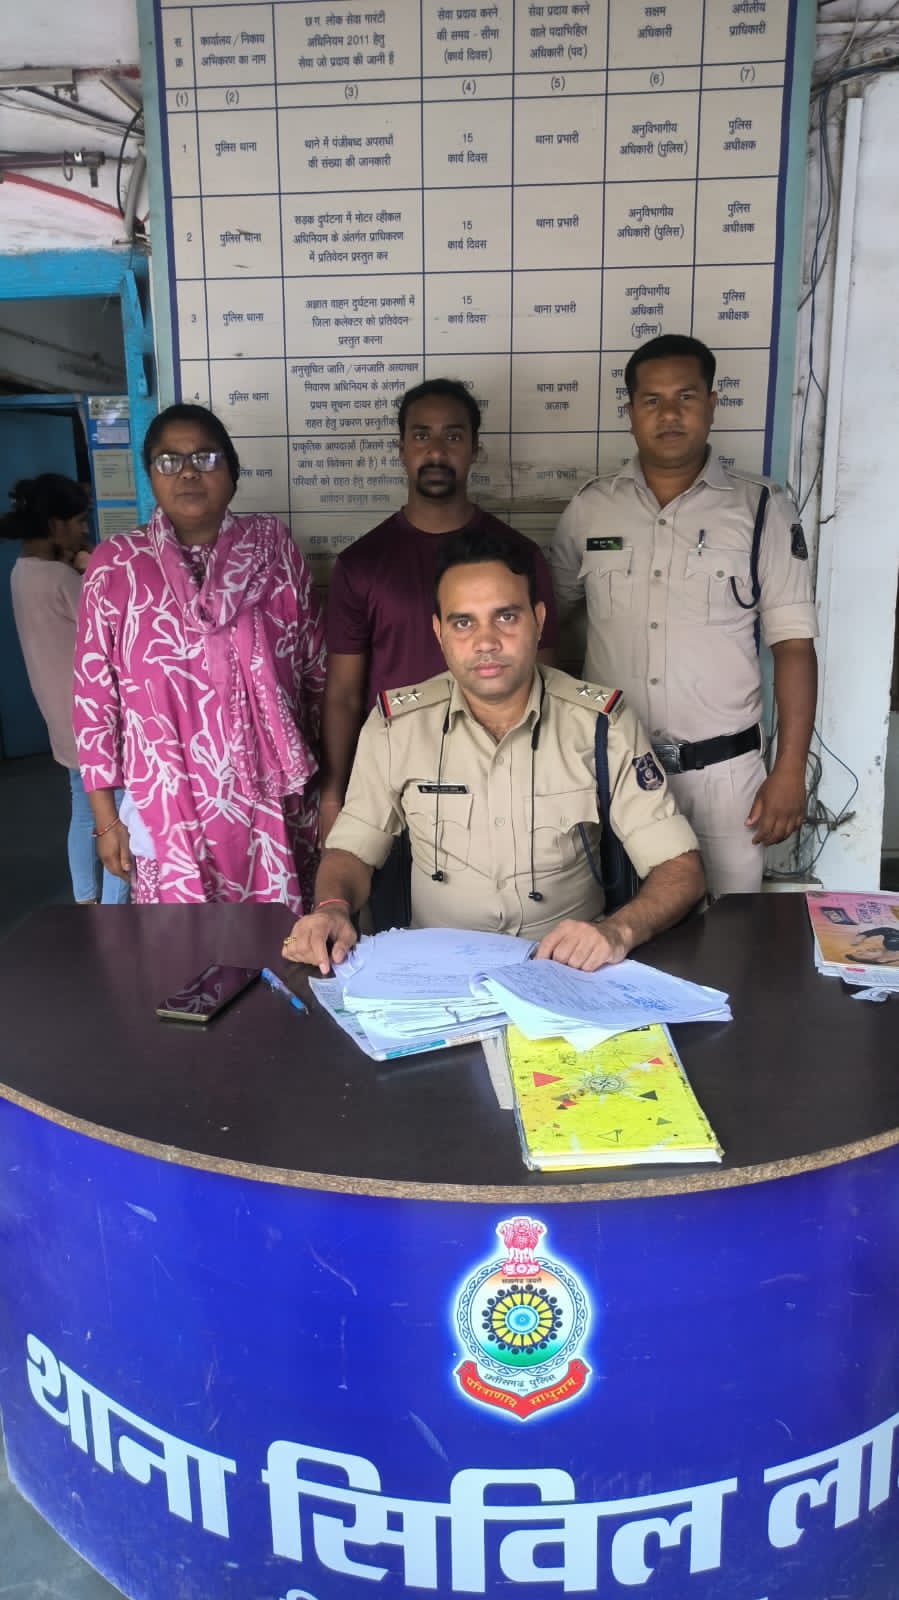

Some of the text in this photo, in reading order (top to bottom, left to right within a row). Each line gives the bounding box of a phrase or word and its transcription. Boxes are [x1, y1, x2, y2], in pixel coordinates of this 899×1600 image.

[437, 8, 453, 20] सेवा
[480, 5, 498, 18] करने
[528, 1, 590, 16] सेवा प्रदाय करने
[645, 6, 667, 16] सक्षम
[325, 13, 343, 26] लोक
[345, 12, 362, 24] सेवा
[437, 27, 448, 40] की
[450, 30, 471, 40] समय
[638, 24, 672, 39] अधिकारी
[307, 32, 385, 48] अधिनियम 2011 हेतु
[239, 56, 248, 64] का
[251, 54, 266, 64] नाम
[530, 44, 587, 60] अधिकारी (पद)
[298, 56, 314, 69] सेवा
[352, 52, 363, 66] की
[650, 71, 664, 88] (6)
[740, 64, 755, 83] (7)
[462, 80, 476, 95] (4)
[551, 76, 565, 91] (5)
[175, 90, 189, 107] (1)
[225, 88, 239, 105] (2)
[344, 84, 358, 100] (3)
[632, 120, 677, 141] अनुविभागीय
[729, 117, 752, 135] पुलिस
[304, 136, 320, 149] थाने
[463, 132, 473, 144] 15
[536, 130, 579, 144] थाना प्रभारी
[215, 140, 256, 157] पुलिस थाना
[620, 140, 688, 158] अधिकारी (पुलिस)
[308, 156, 318, 168] की
[345, 154, 355, 167] की
[359, 152, 391, 167] जानकारी
[448, 150, 488, 163] कार्य दिवस
[355, 210, 373, 223] मोटर
[628, 204, 674, 223] अनुविभागीय
[728, 201, 751, 221] पुलिस
[462, 220, 472, 230] 15
[536, 214, 579, 228] थाना प्रभारी
[187, 232, 192, 242] 2
[220, 230, 241, 247] पुलिस
[331, 231, 339, 242] के
[617, 224, 684, 240] अधिकारी (पुलिस)
[448, 237, 487, 250] कार्य दिवस
[625, 284, 670, 300] अनुविभागीय
[722, 289, 746, 309] पुलिस
[462, 296, 472, 304] 15
[534, 301, 576, 314] थाना प्रभारी
[630, 303, 664, 316] अधिकारी
[223, 311, 243, 326] पुलिस
[312, 315, 331, 327] जिला
[448, 312, 487, 324] कार्य दिवस
[630, 321, 662, 339] (पुलिस)
[363, 336, 383, 344] करना
[370, 379, 378, 391] के
[537, 380, 578, 392] थाना प्रभारी
[717, 376, 740, 394] पुलिस
[229, 390, 270, 406] पुलिस थाना
[716, 393, 744, 408] धीक्षक
[529, 1374, 557, 1389] पुलिस
[26, 1334, 899, 1594] थाना सिविल ला
